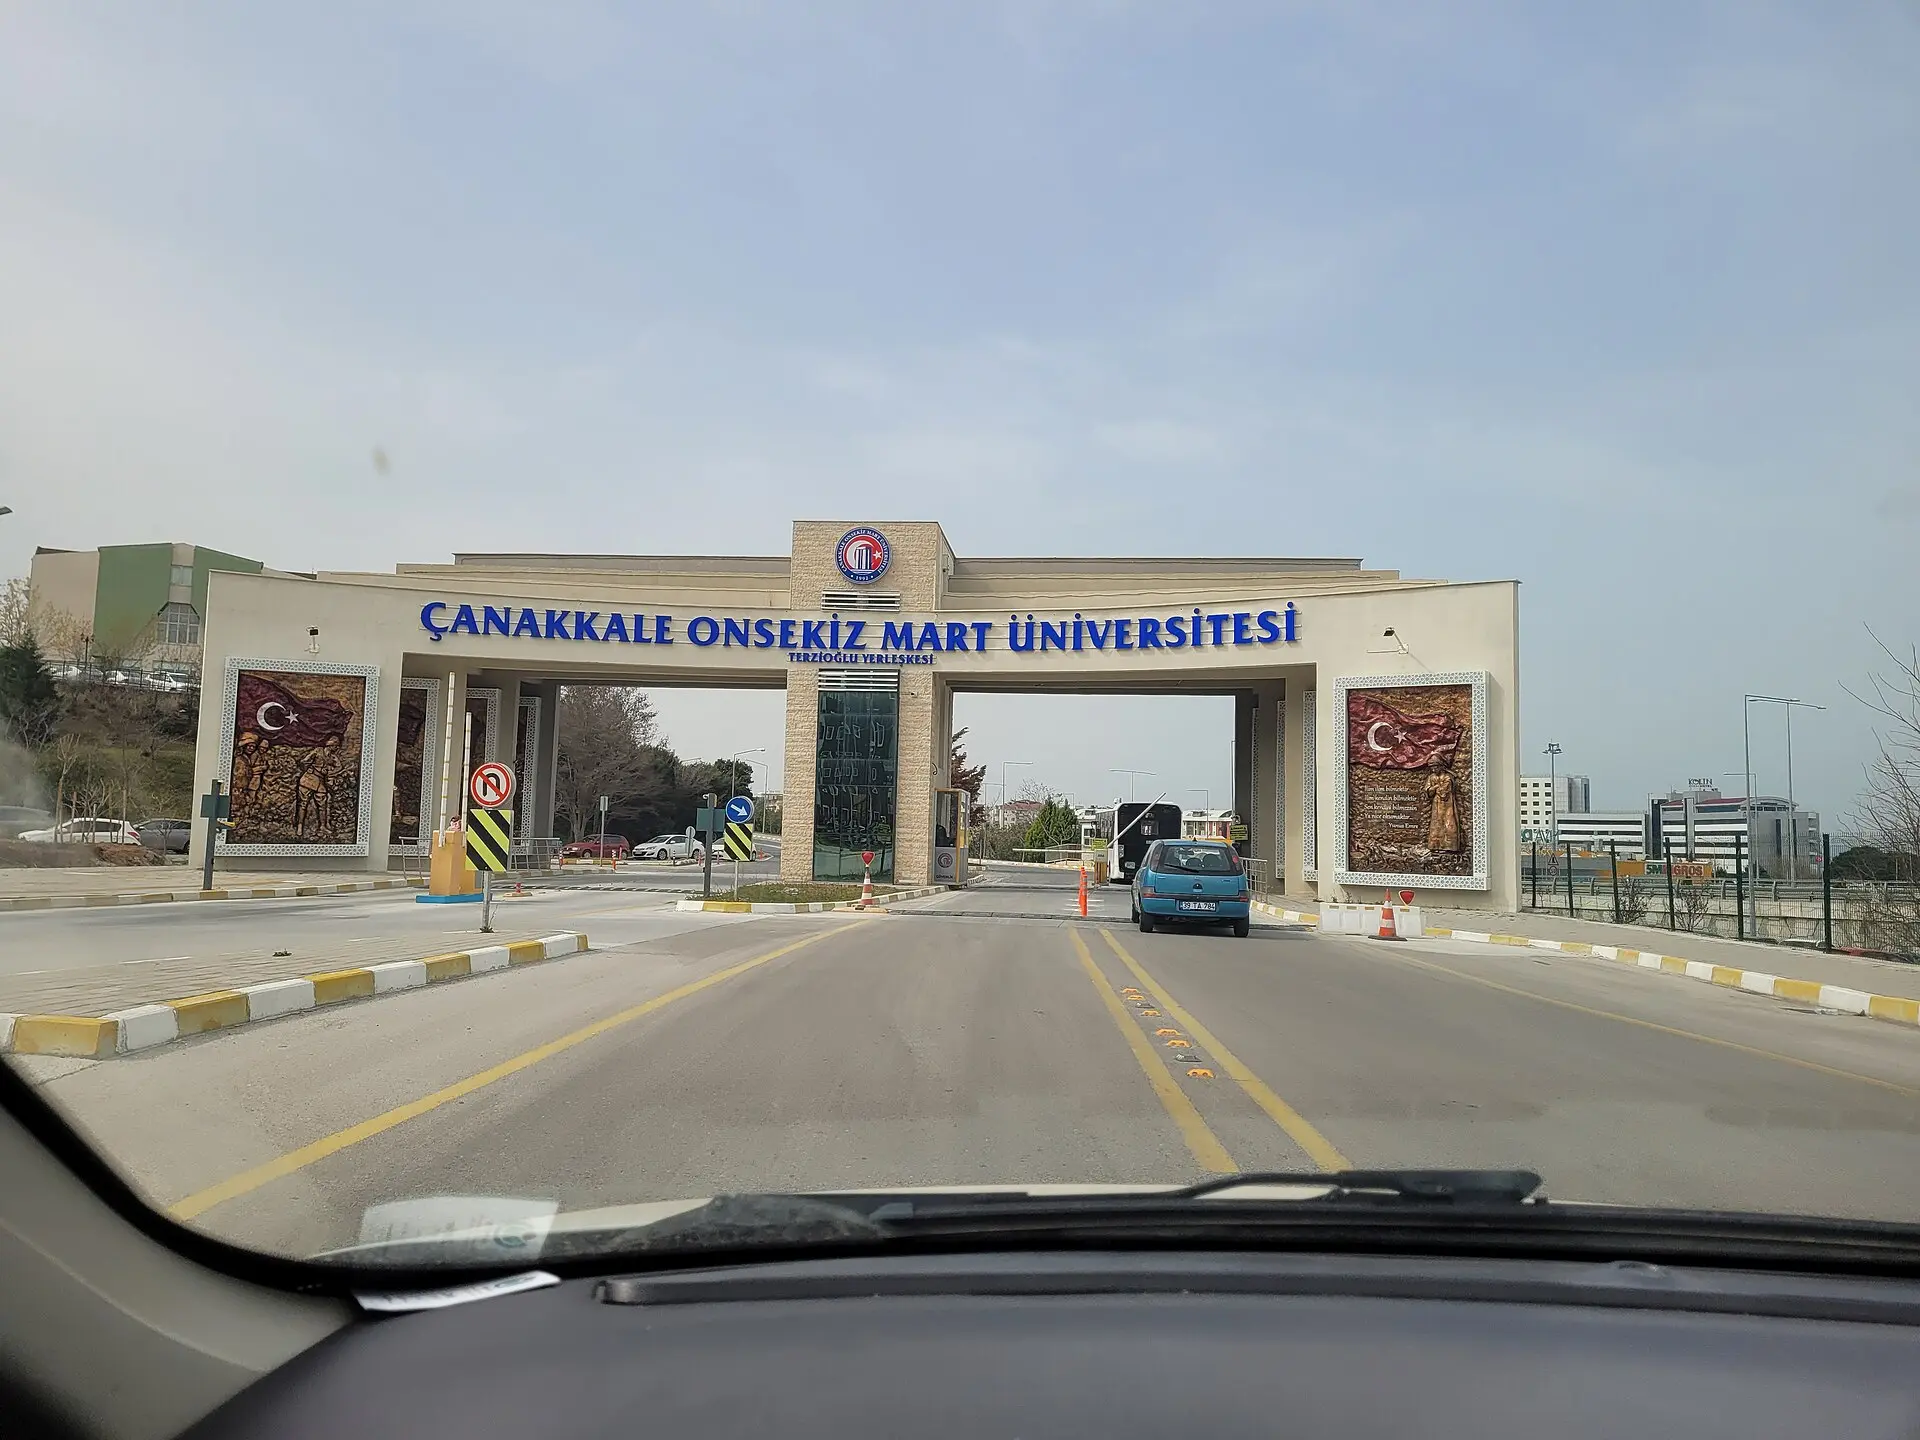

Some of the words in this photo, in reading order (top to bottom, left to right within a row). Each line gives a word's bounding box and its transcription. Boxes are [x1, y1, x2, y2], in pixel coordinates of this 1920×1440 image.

[421, 602, 674, 644] ÇANAKKALE
[687, 613, 867, 650] ONSEKİZ
[881, 621, 993, 652] MART
[1008, 601, 1298, 652] ÜNİVERSİTESİ
[788, 651, 859, 663] TERZİOĞLU
[862, 653, 935, 667] YERLEŞKESİ
